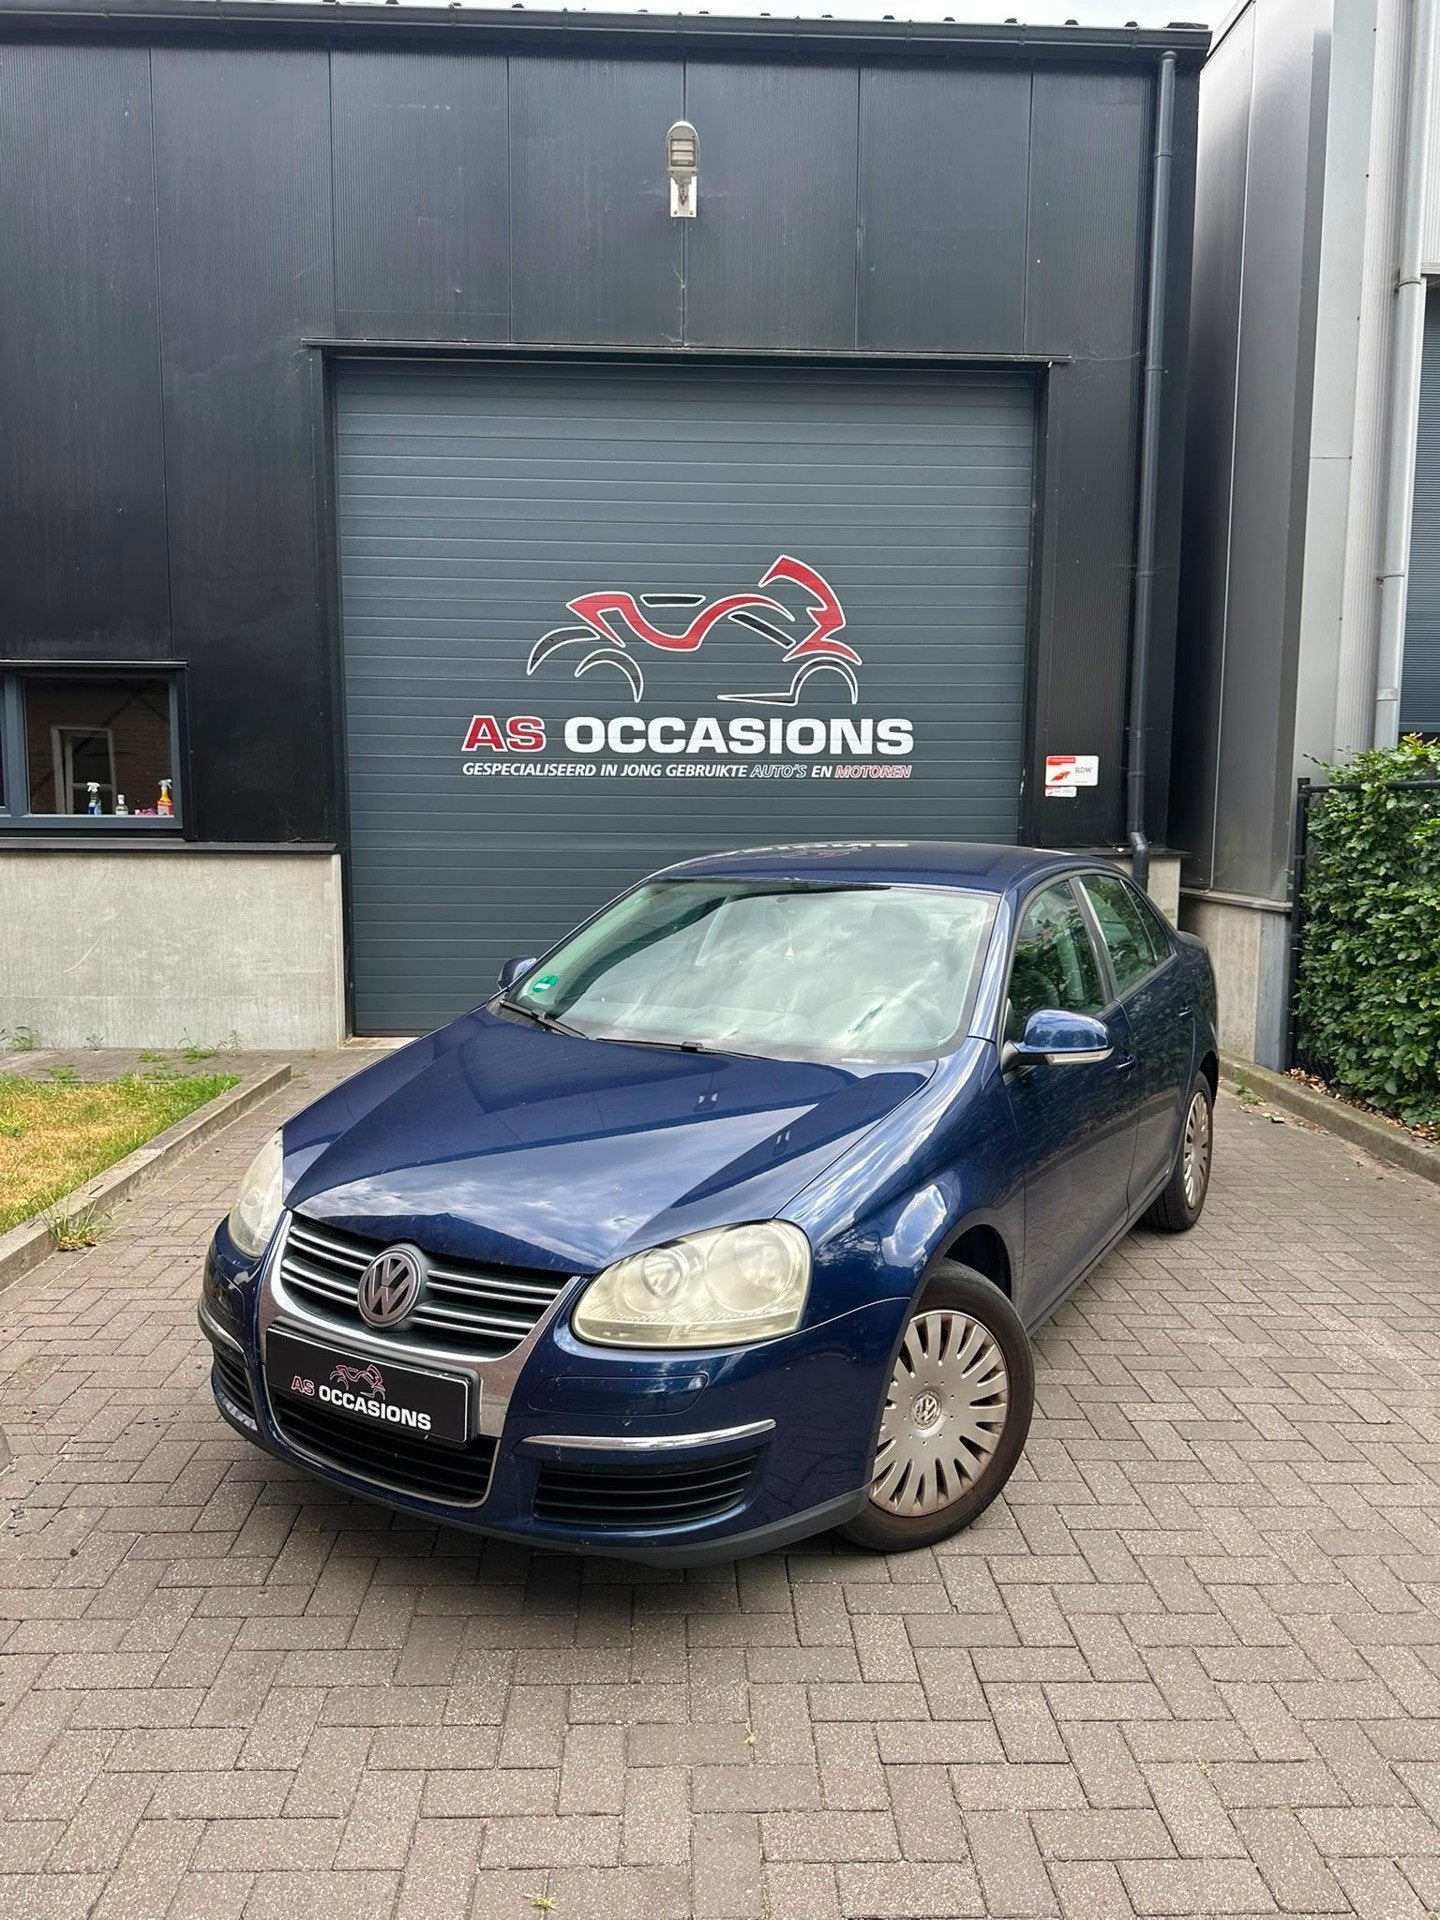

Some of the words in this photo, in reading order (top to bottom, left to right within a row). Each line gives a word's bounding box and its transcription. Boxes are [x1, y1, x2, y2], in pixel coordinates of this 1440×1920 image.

[461, 715, 547, 752] AS
[564, 716, 914, 755] OCCASIONS
[462, 762, 597, 777] GESPECIALISEERD
[600, 764, 618, 777] IN
[621, 764, 661, 777] JONG
[666, 764, 748, 778] GEBRUIKTE
[750, 764, 807, 778] AUTO'S
[811, 765, 832, 778] EN
[834, 765, 912, 779] MOTOREN
[290, 1375, 315, 1396] AS
[319, 1385, 432, 1431] OCCASIONS
